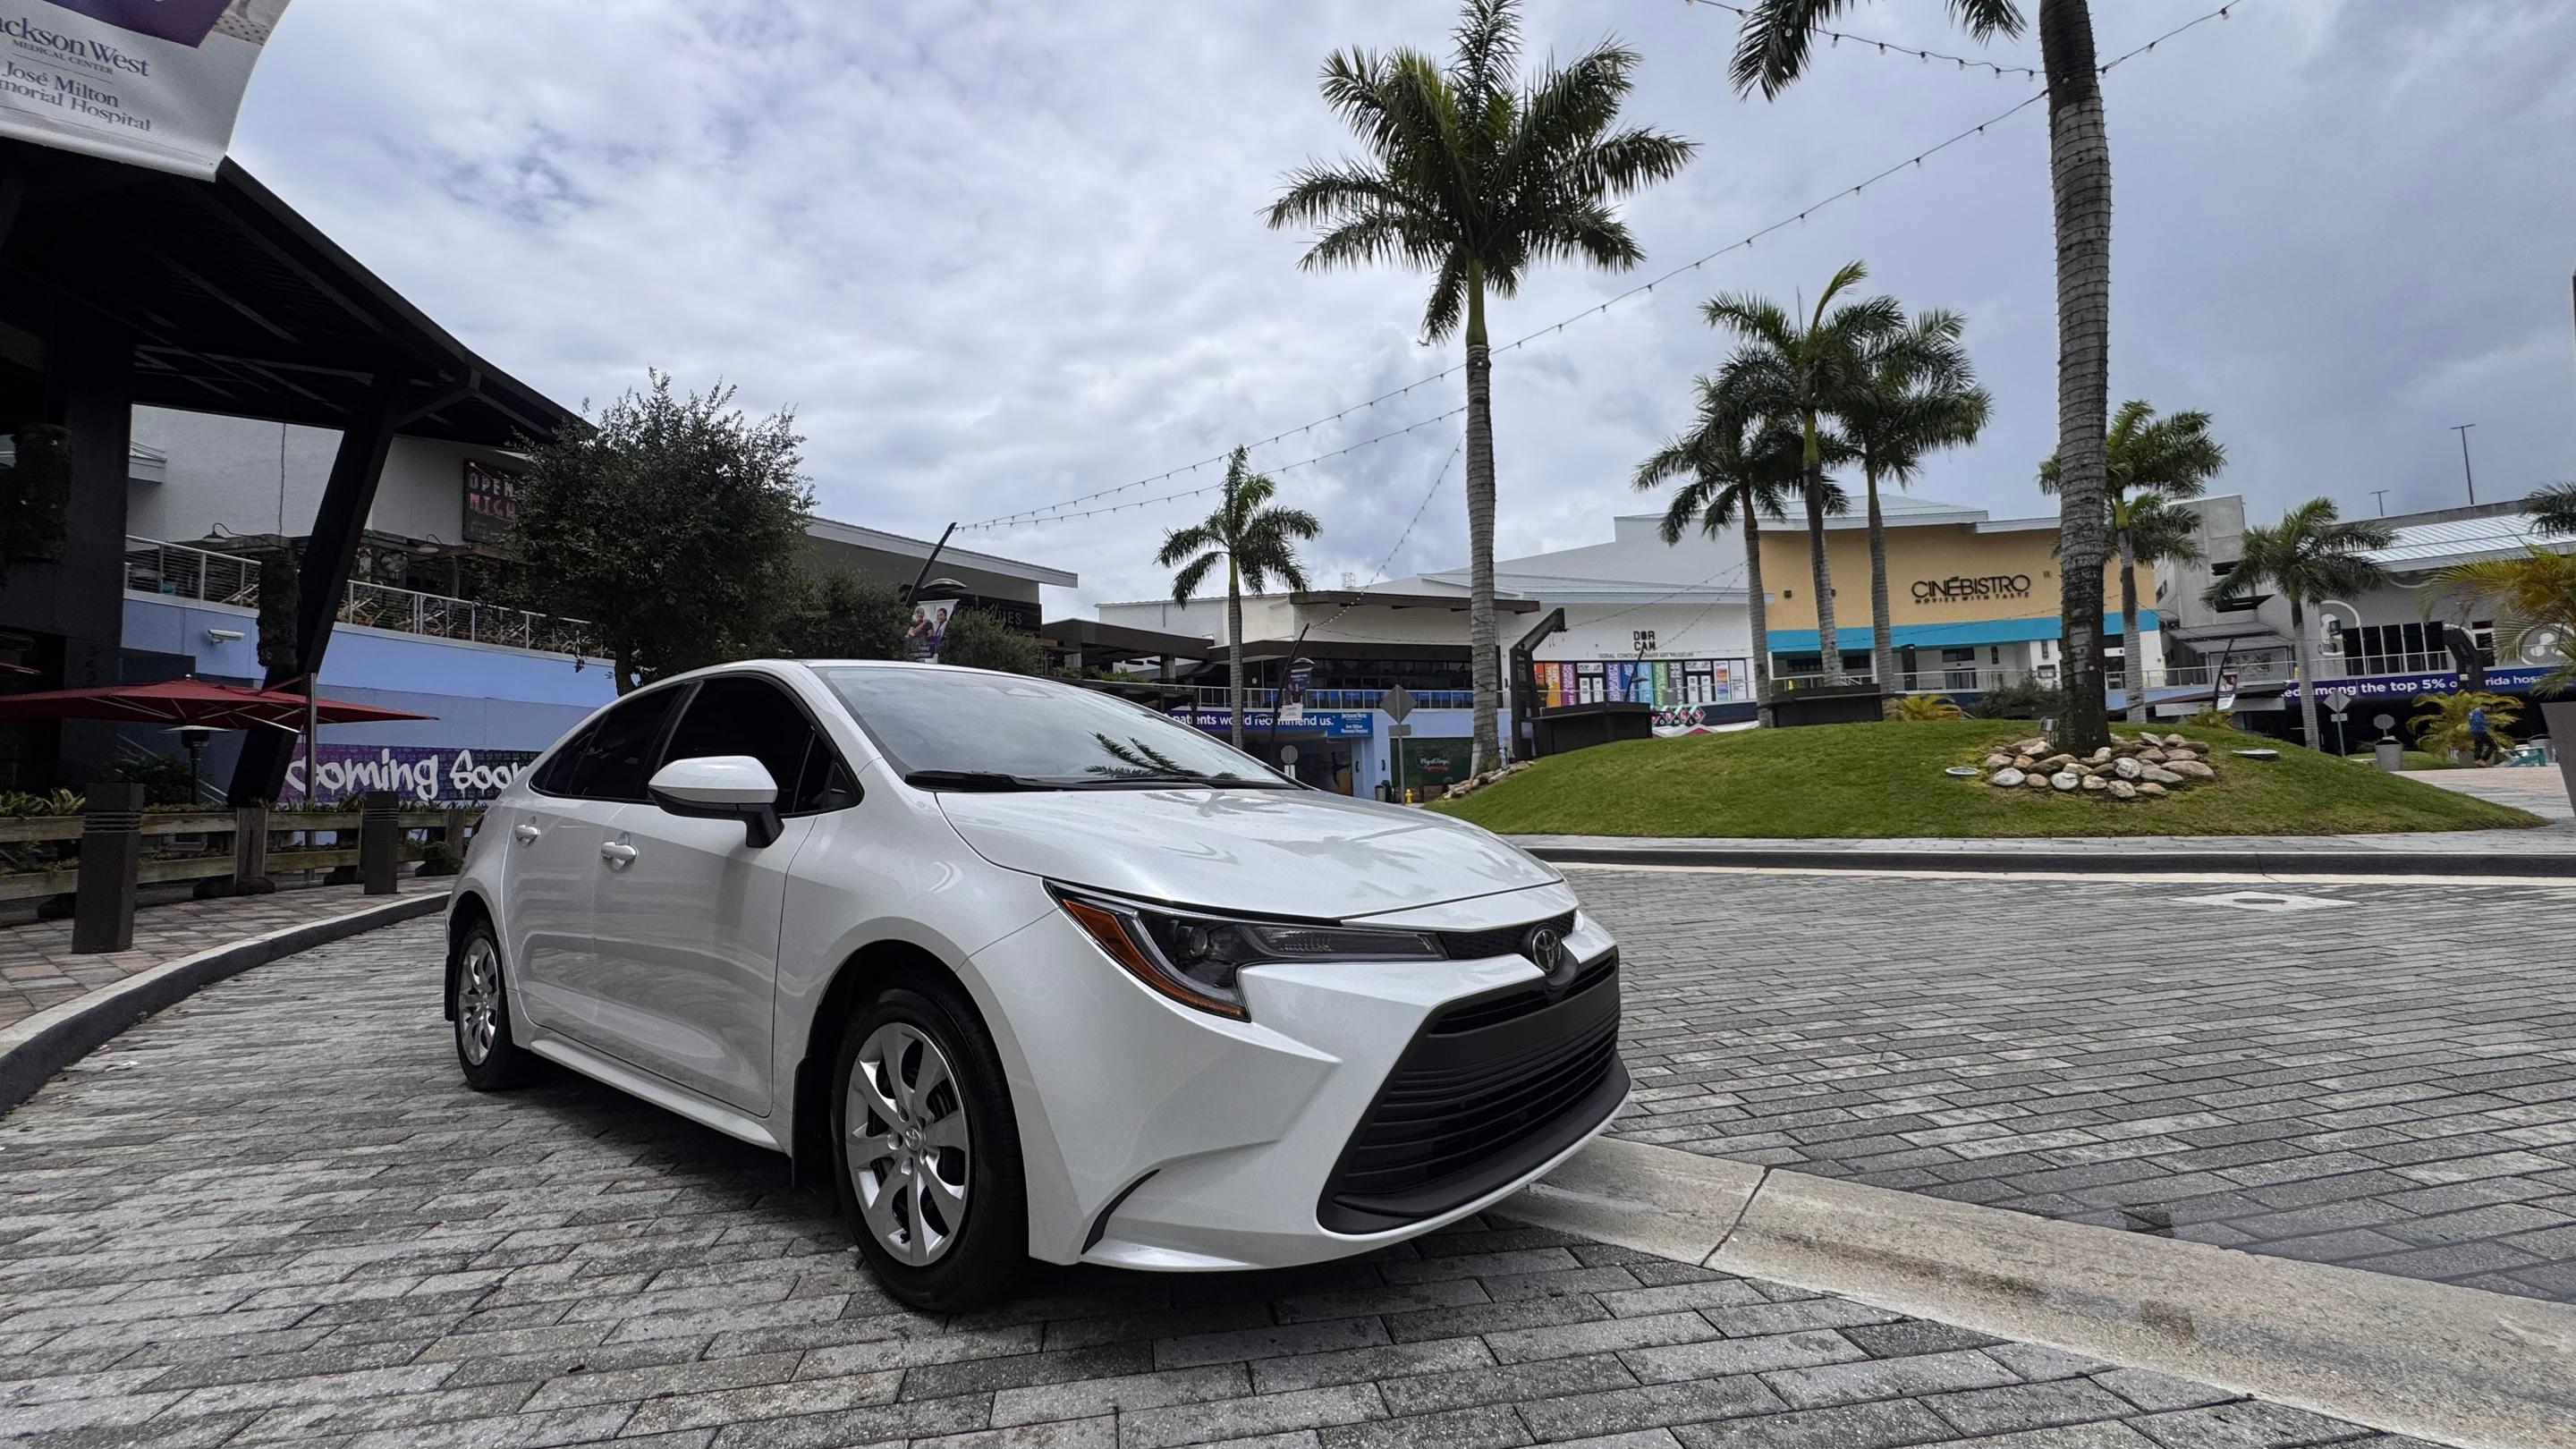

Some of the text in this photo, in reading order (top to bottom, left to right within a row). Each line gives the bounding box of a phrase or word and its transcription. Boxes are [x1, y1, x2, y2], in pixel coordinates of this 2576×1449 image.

[0, 16, 150, 77] ckson West
[13, 38, 114, 75] MEDICAL CENTER
[2, 61, 119, 108] José Milton
[0, 79, 152, 131] morial Hospital
[1911, 574, 2031, 597] CINÉBISTRO
[1915, 597, 1956, 605] MOVIES
[1996, 591, 2029, 599] TASTE
[1634, 641, 1656, 651] CAM
[2312, 685, 2356, 696] mong
[2361, 682, 2386, 693] the
[2390, 681, 2418, 693] top
[2421, 679, 2446, 690] 5%
[1219, 715, 1252, 725] wod
[285, 748, 438, 801] Coming
